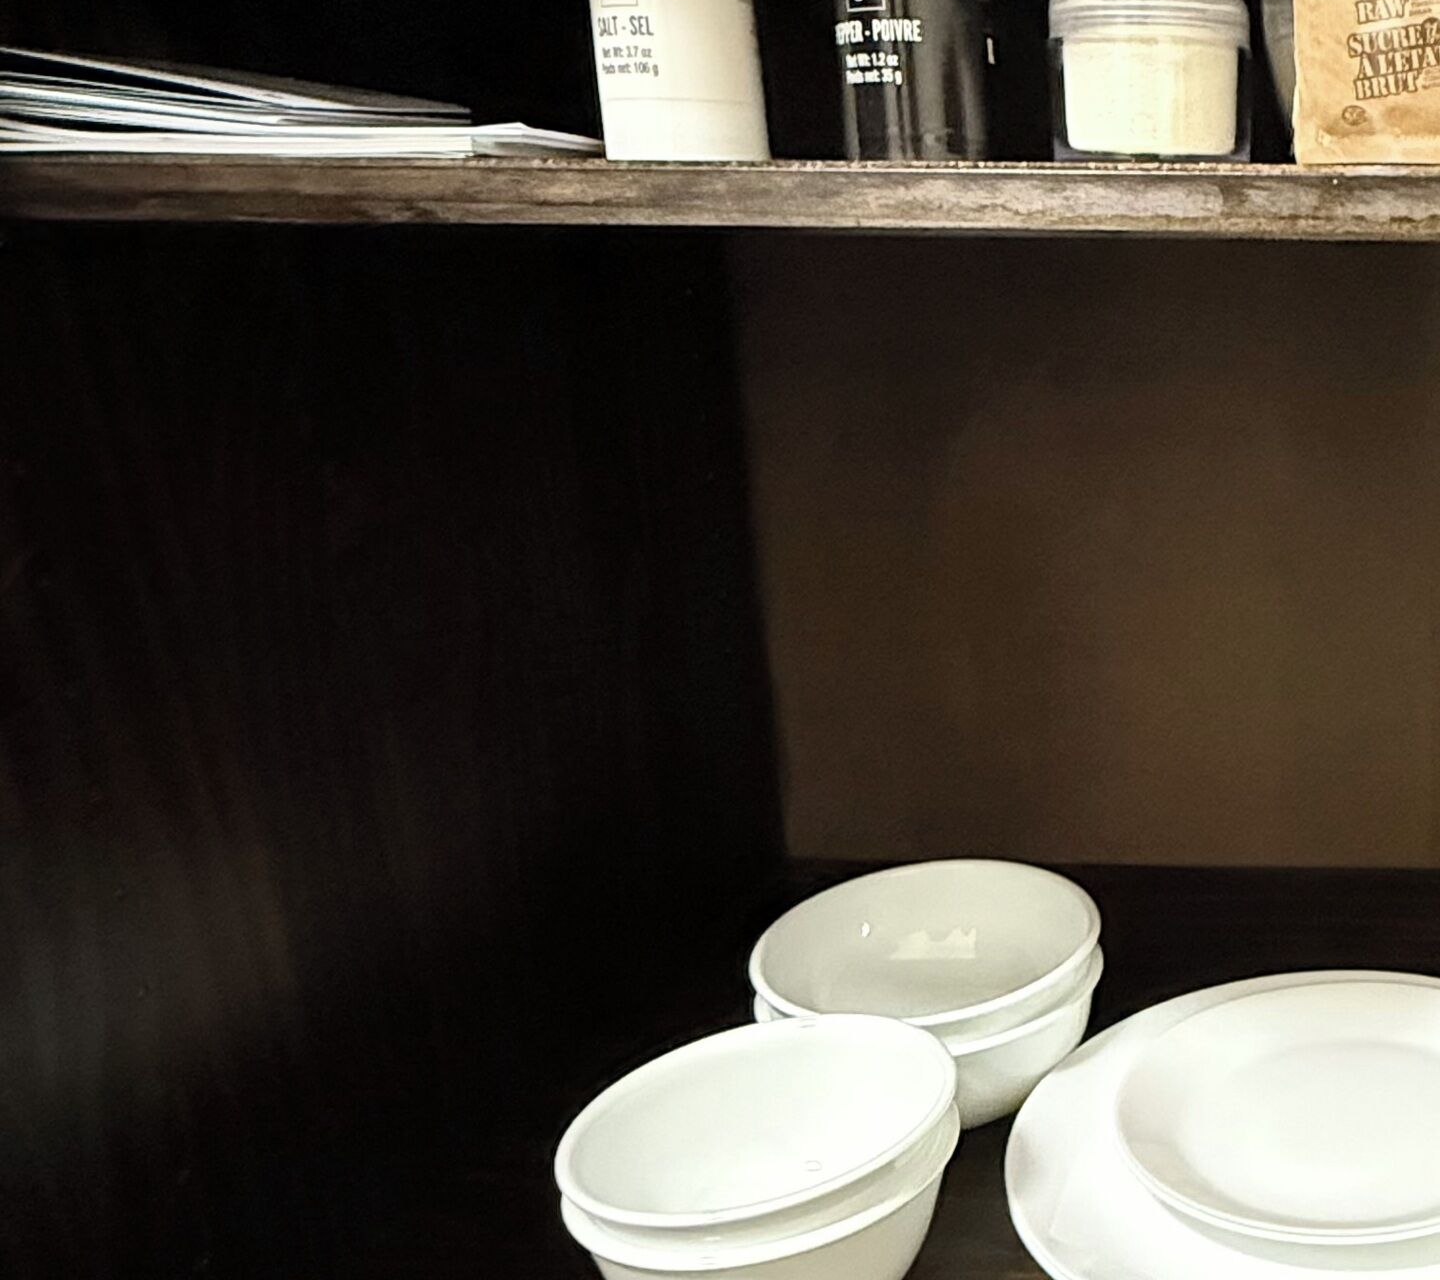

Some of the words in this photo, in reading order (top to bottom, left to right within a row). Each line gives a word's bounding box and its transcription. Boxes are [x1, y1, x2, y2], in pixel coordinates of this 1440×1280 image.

[598, 15, 618, 37] SALT
[629, 15, 654, 36] SEL
[871, 18, 923, 43] POIVRE
[1347, 24, 1424, 58] SUCRE
[1353, 70, 1419, 101] BRUT
